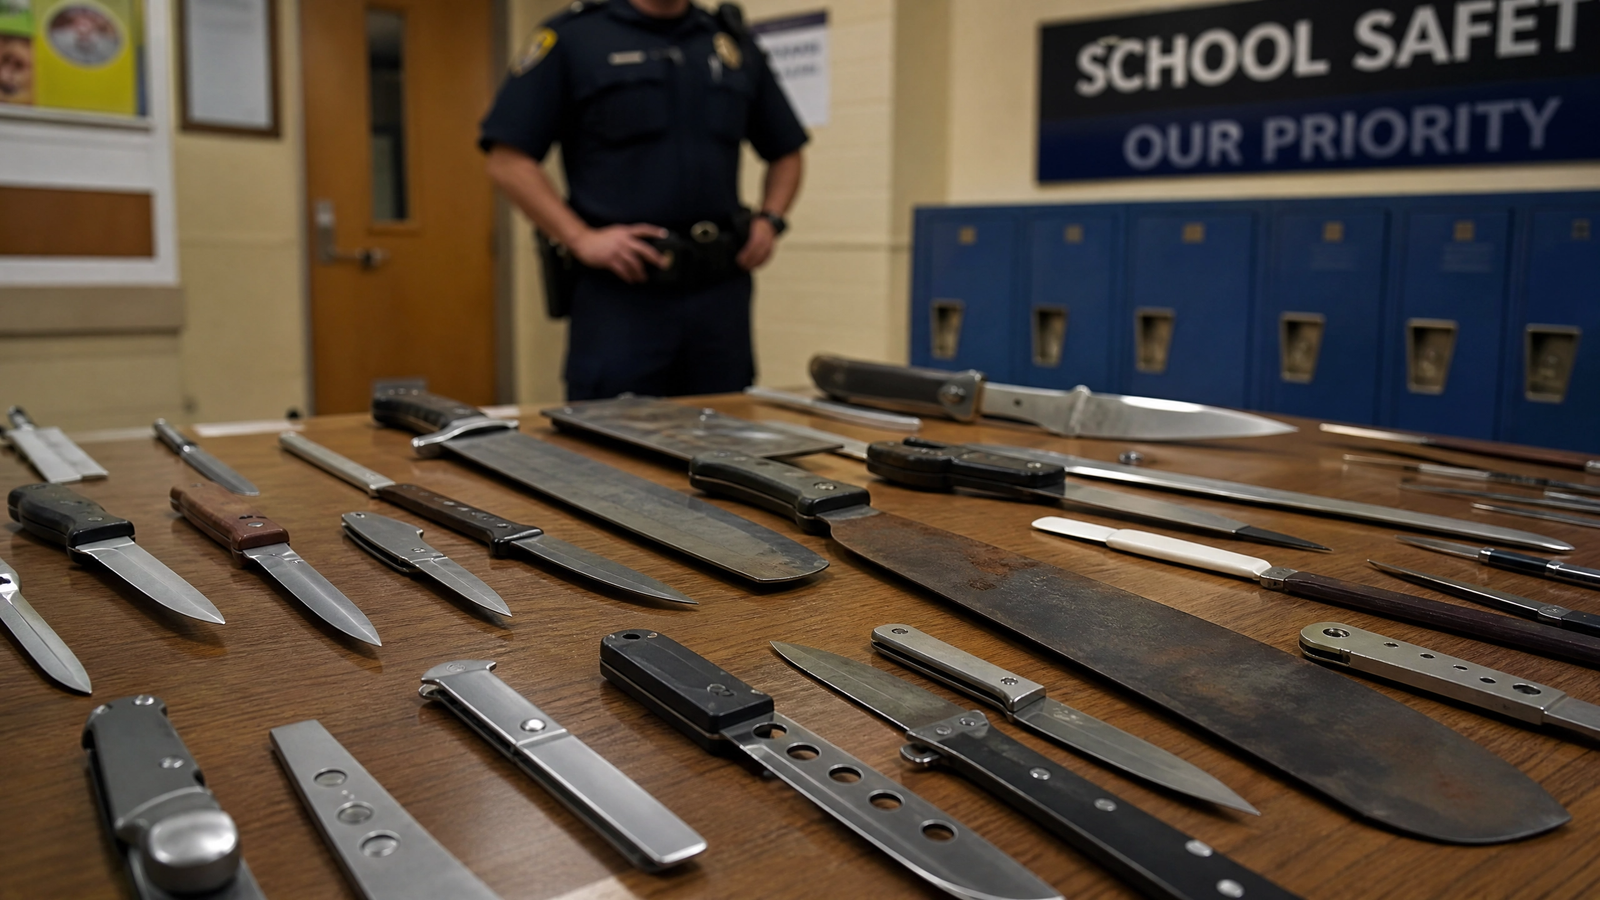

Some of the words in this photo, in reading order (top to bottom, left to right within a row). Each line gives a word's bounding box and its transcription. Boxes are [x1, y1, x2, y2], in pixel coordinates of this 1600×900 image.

[1075, 20, 1330, 97] SCHOOL
[1353, 0, 1600, 71] SAFET
[1123, 119, 1243, 168] OUR
[1263, 97, 1560, 163] PRIORITY
